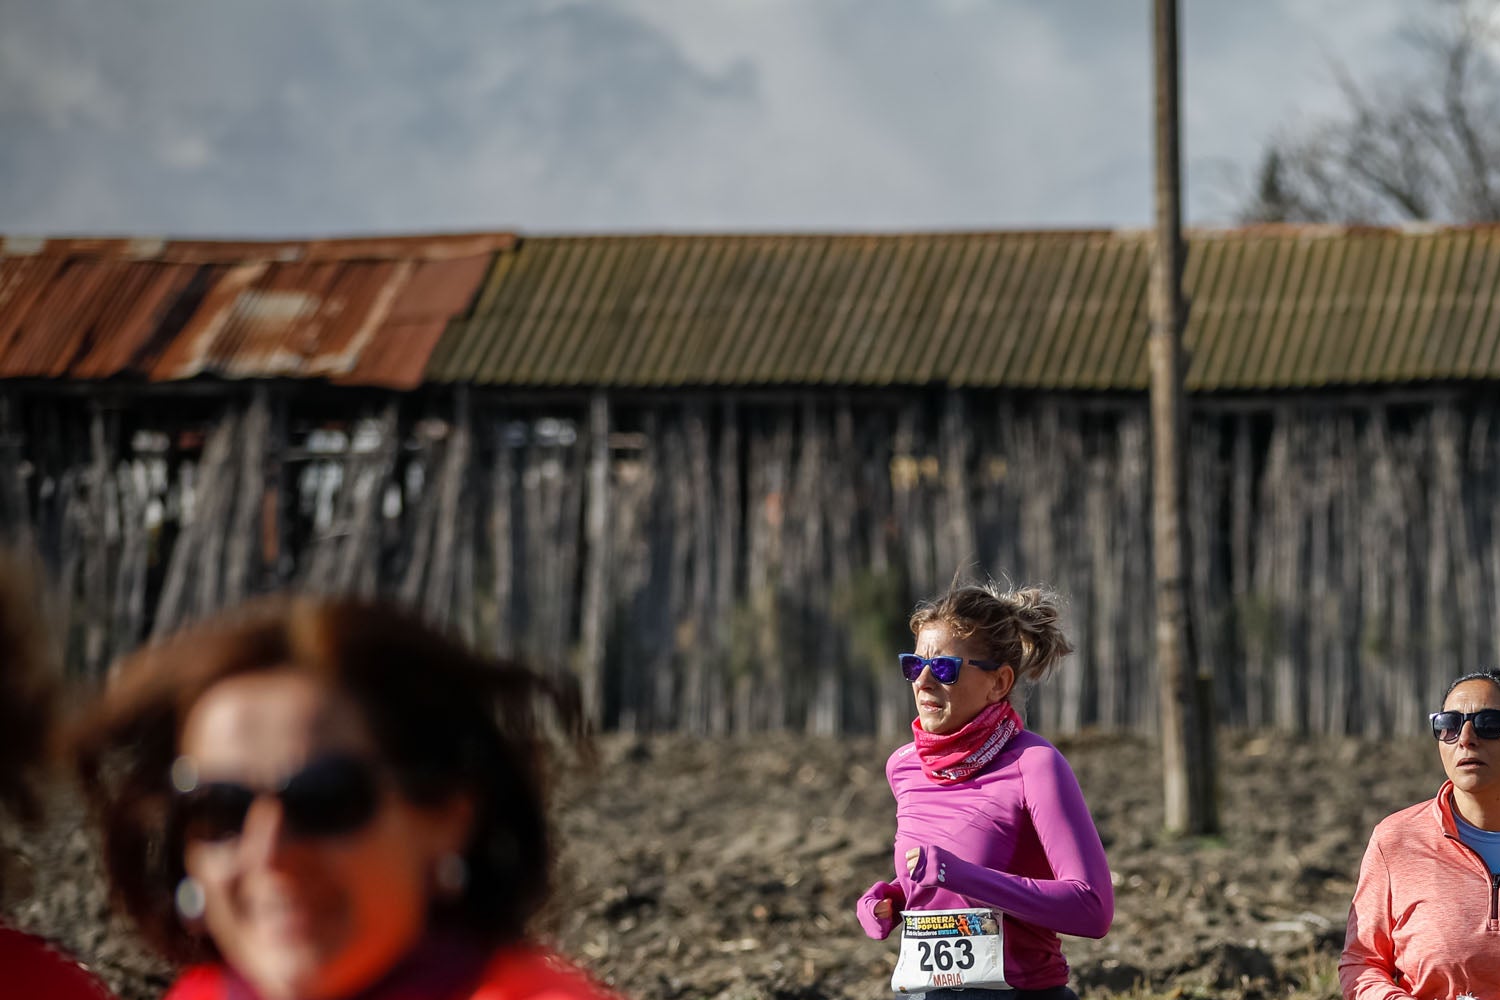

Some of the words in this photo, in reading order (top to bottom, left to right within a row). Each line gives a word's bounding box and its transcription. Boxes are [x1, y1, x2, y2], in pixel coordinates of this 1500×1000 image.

[917, 915, 955, 924] CARRERA
[918, 939, 975, 972] 263
[933, 973, 963, 987] MARIA
